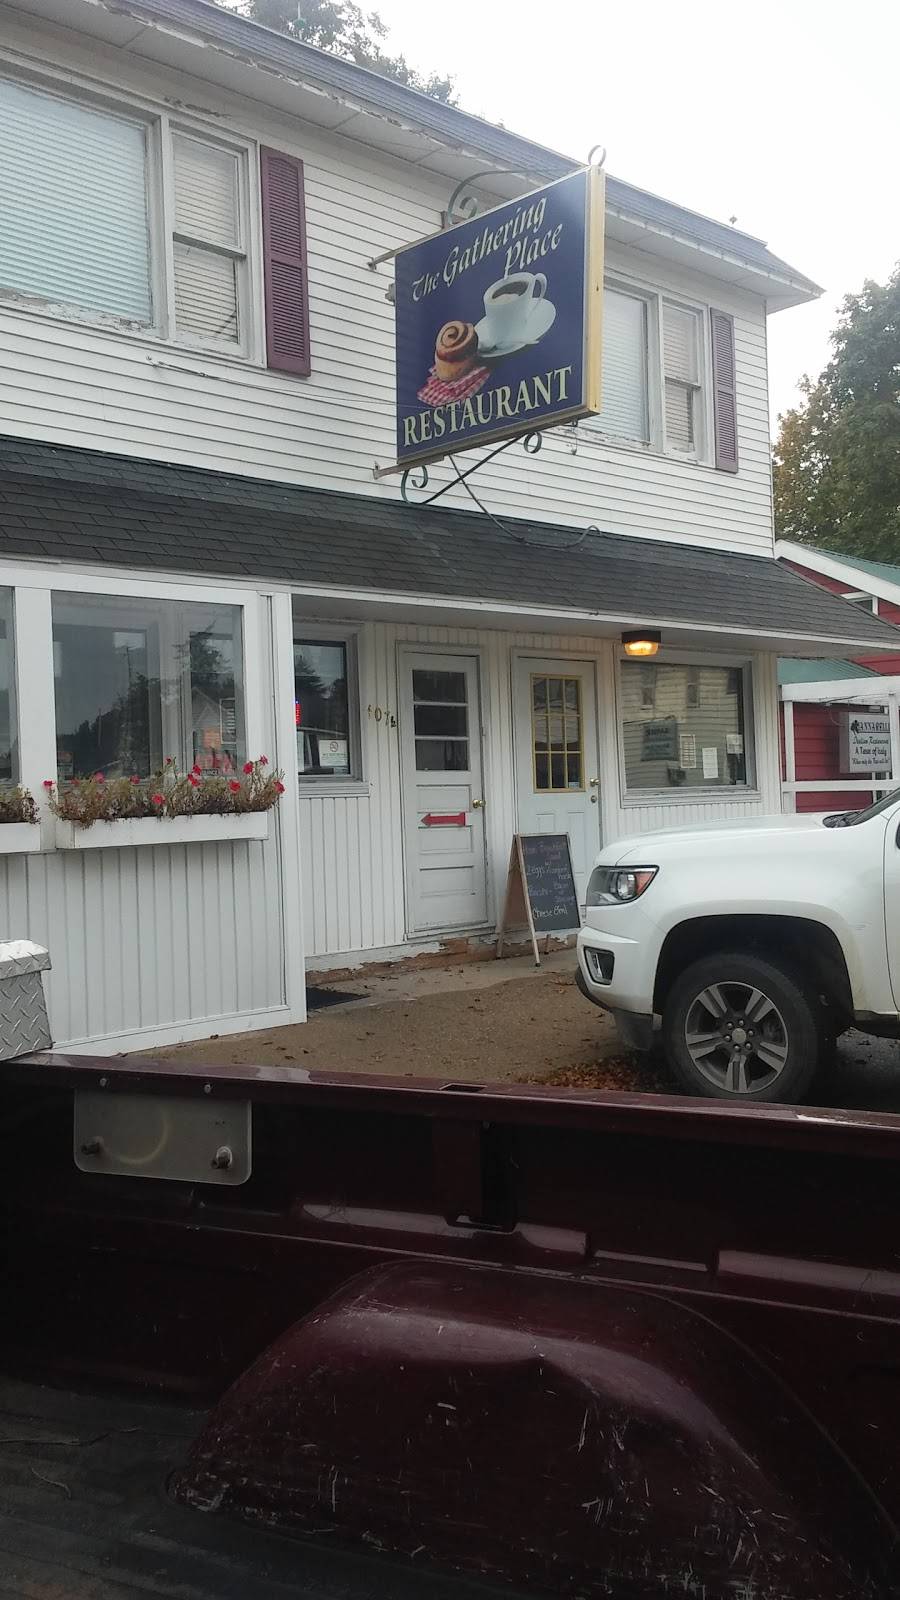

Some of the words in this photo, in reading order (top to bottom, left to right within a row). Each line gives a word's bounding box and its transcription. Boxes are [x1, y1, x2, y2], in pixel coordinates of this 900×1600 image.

[411, 273, 440, 302] The
[443, 195, 547, 288] Gathering
[503, 221, 563, 278] Place
[402, 365, 573, 447] RESTAURANT
